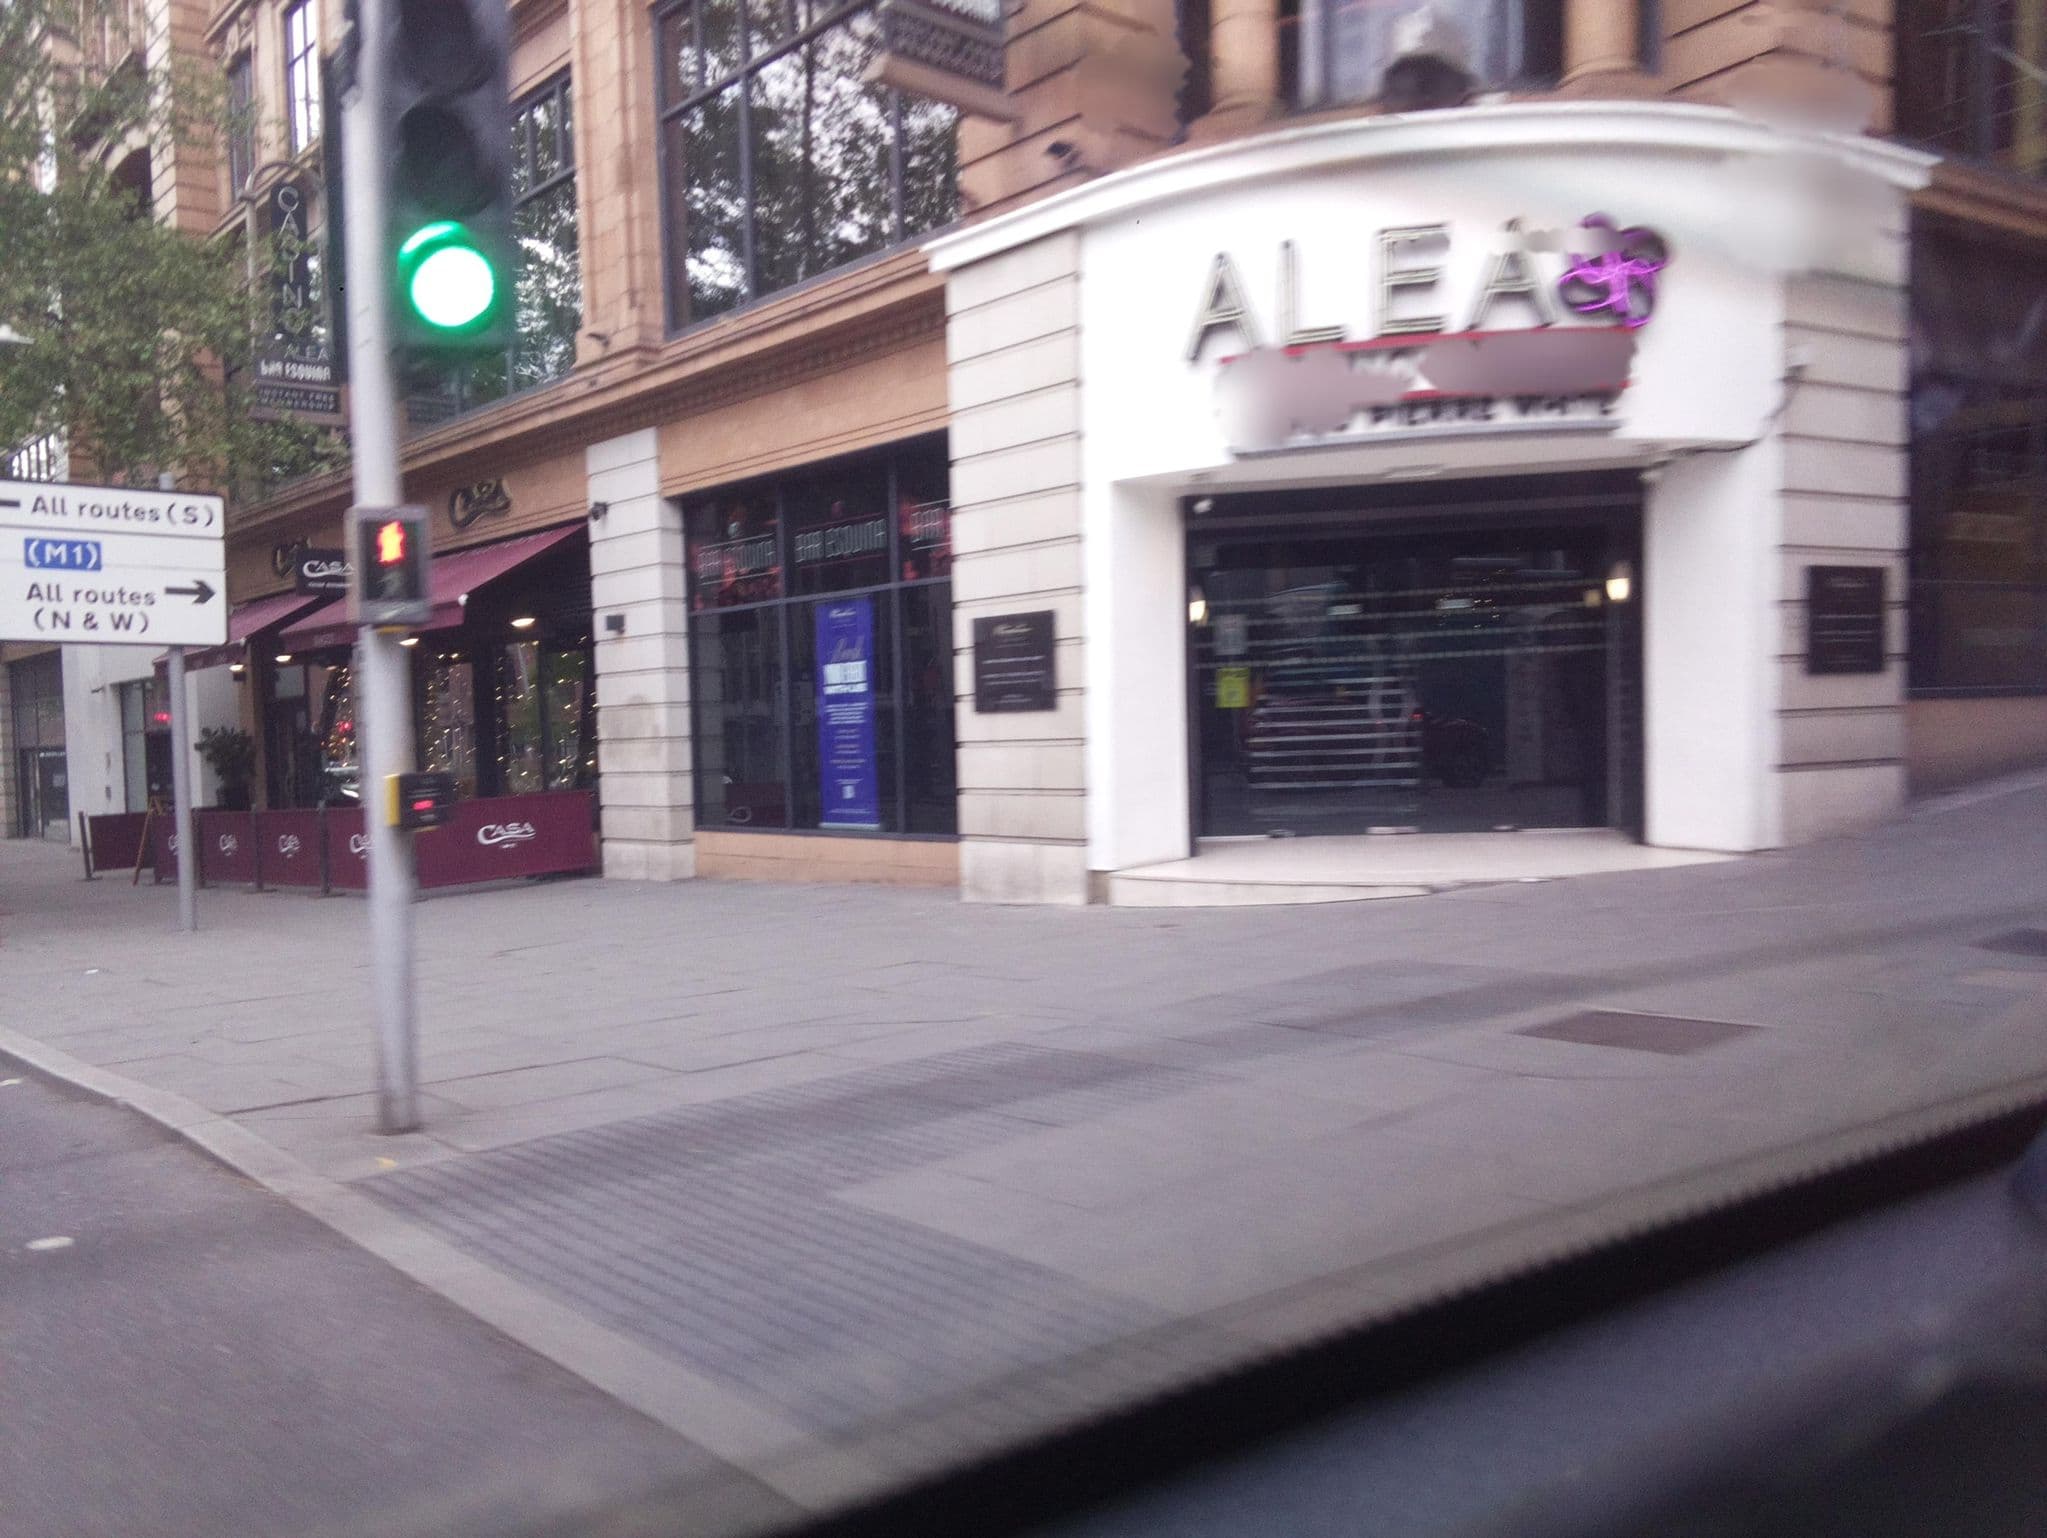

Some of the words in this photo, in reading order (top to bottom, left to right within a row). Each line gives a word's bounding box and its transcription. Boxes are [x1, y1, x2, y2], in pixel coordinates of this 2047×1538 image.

[1186, 217, 1554, 362] ALEA
[31, 496, 67, 516] All
[78, 501, 160, 522] routes
[167, 503, 214, 527] (S)
[27, 539, 98, 569] (M1)
[302, 560, 356, 577] CASA
[26, 583, 62, 601] All
[73, 586, 156, 606] routes
[34, 608, 71, 631] (N
[83, 611, 99, 630] &
[110, 612, 149, 633] W)
[477, 822, 536, 845] CASA
